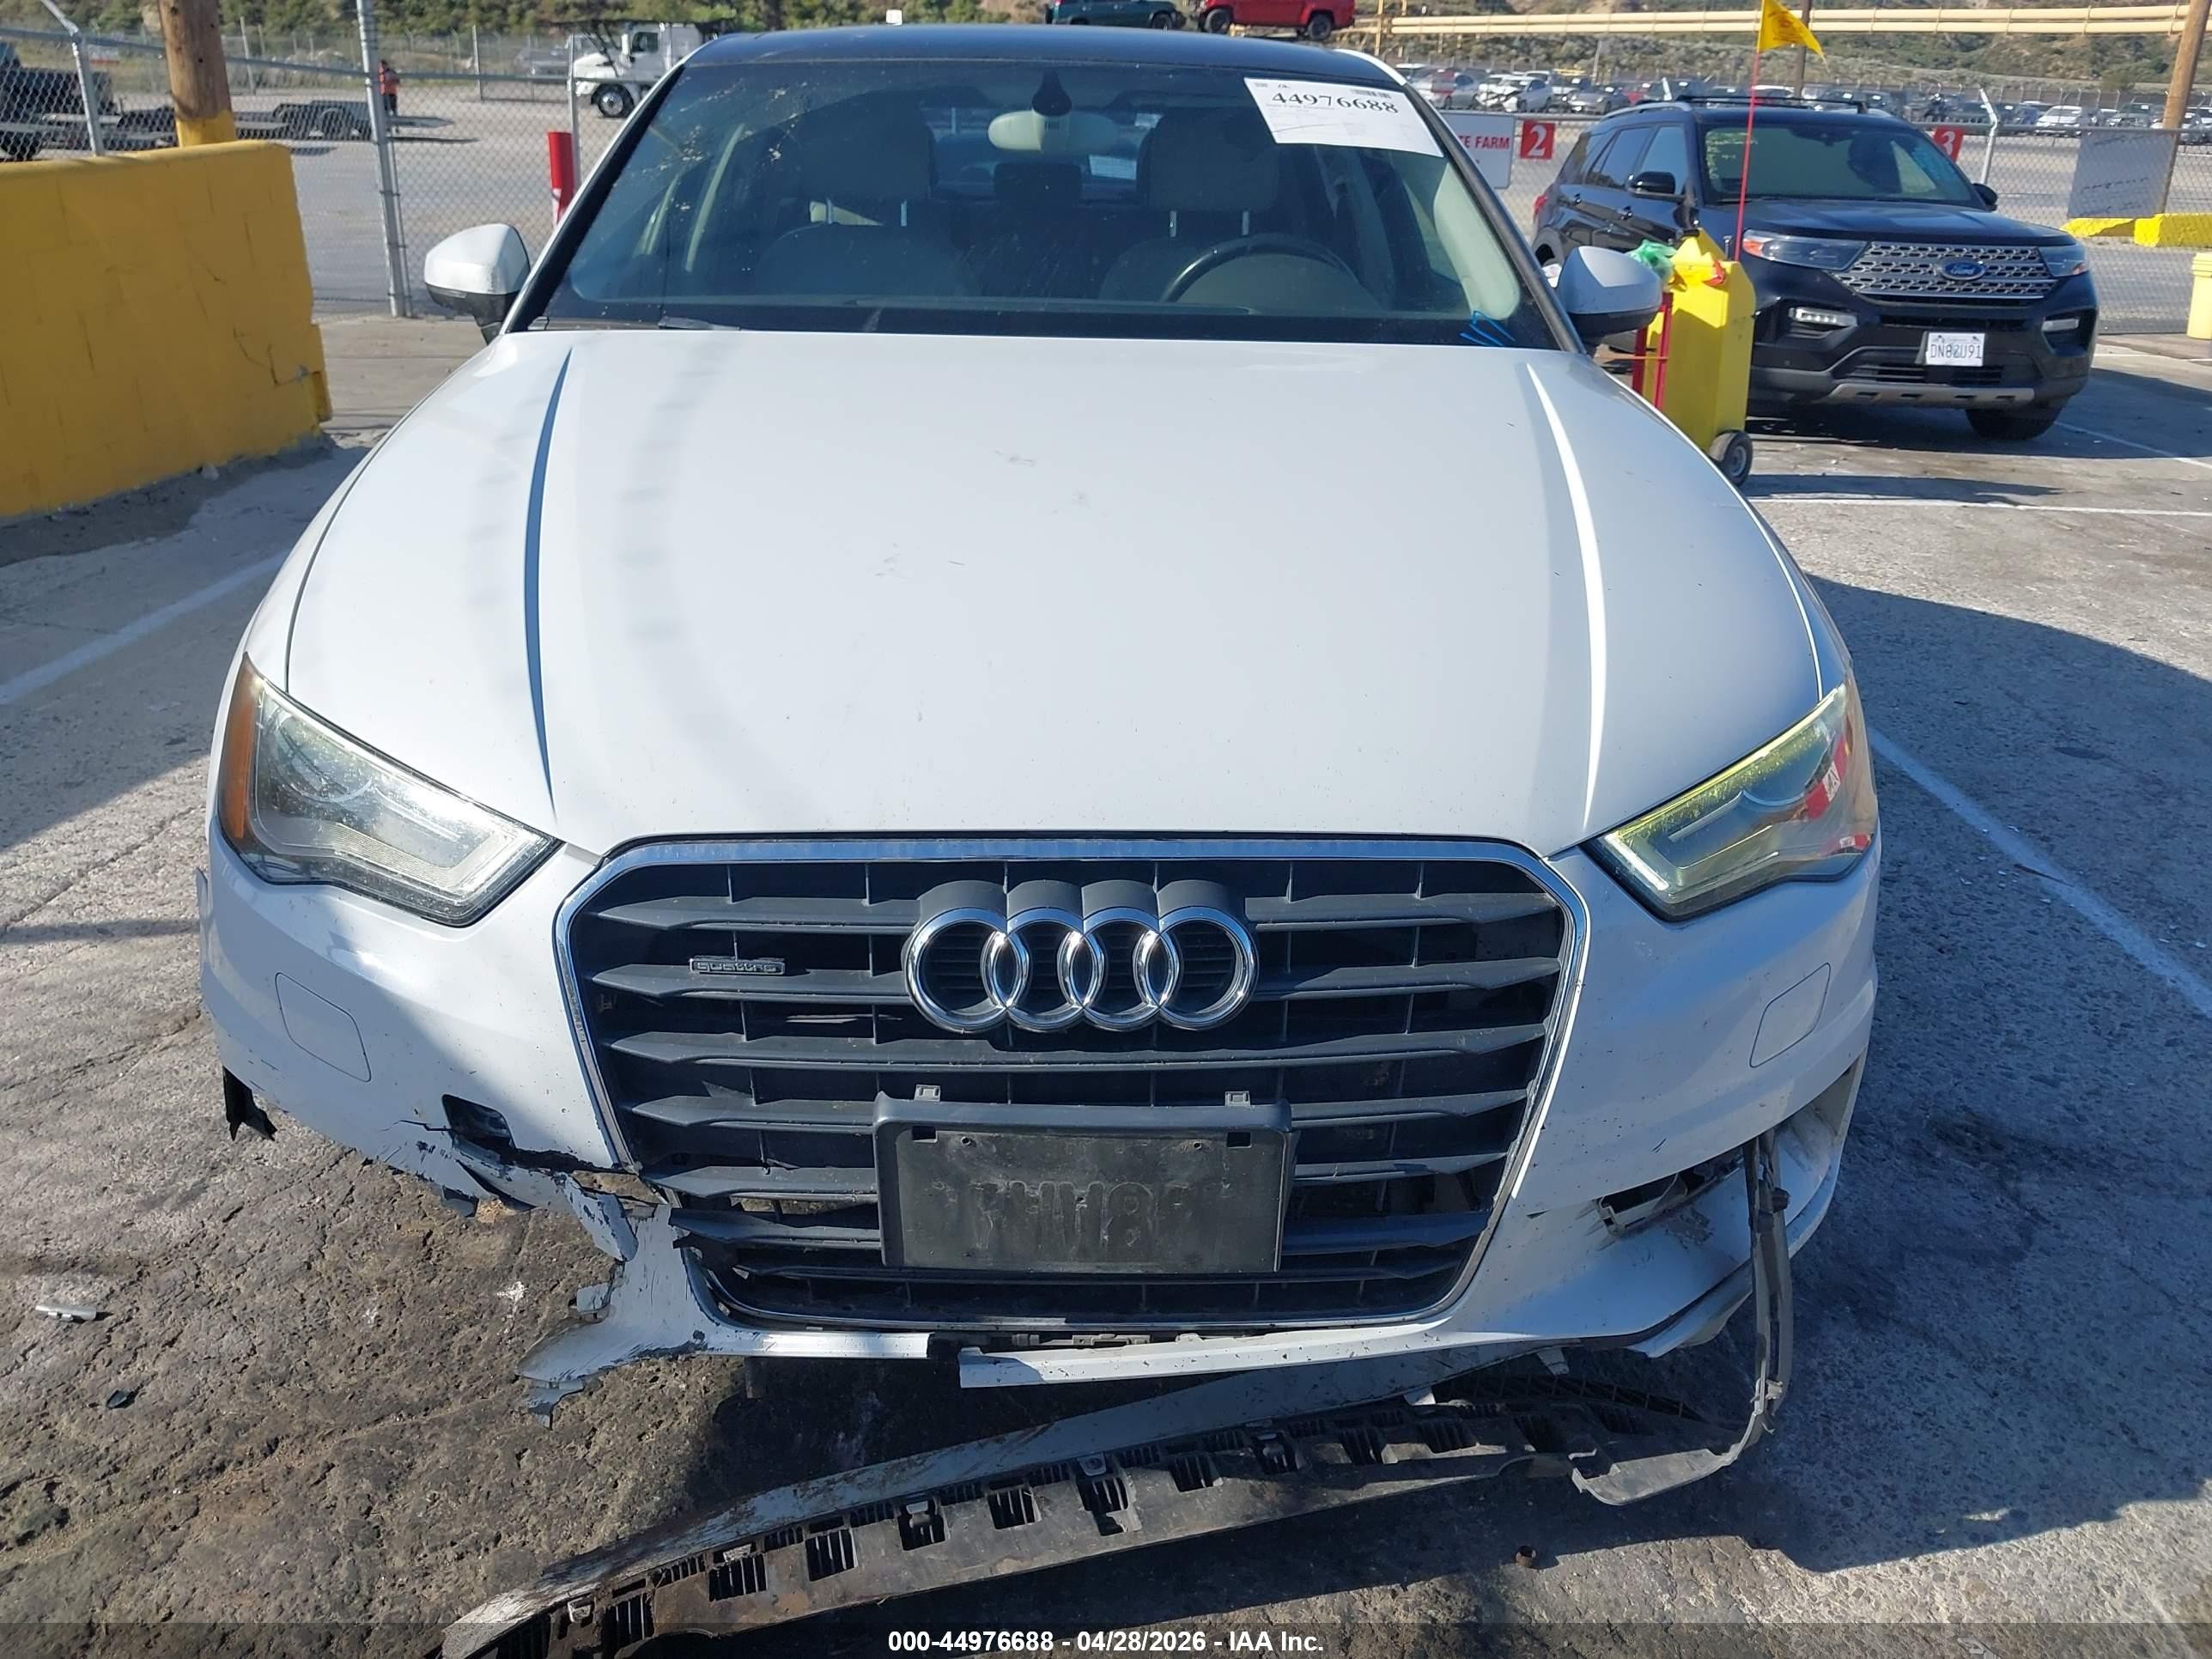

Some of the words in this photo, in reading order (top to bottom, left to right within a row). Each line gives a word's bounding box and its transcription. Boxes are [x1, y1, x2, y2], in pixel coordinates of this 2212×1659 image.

[1272, 92, 1399, 113] 44976688
[1475, 136, 1510, 149] FARM
[1528, 124, 1547, 156] 2
